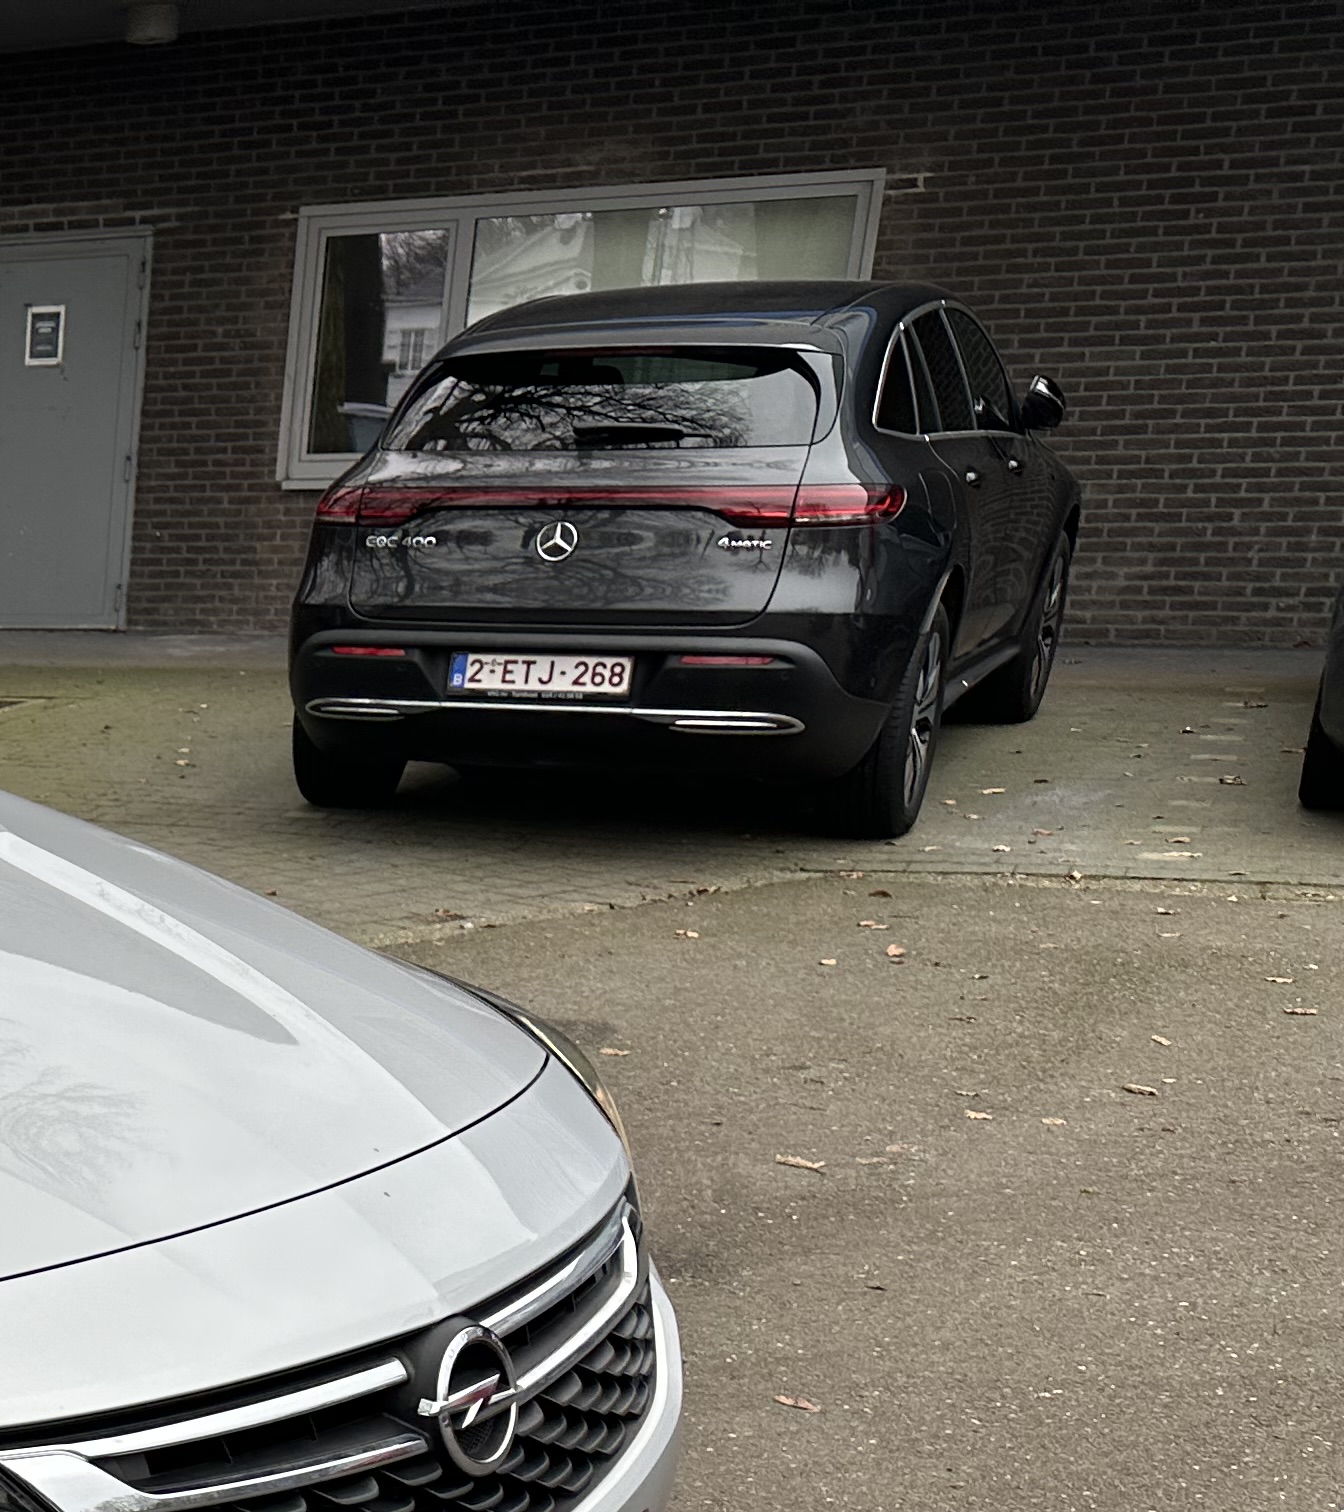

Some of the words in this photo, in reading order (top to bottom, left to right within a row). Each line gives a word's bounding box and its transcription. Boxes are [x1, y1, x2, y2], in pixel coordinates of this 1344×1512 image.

[366, 535, 399, 548] EQC
[401, 536, 437, 548] 400
[453, 673, 463, 686] B
